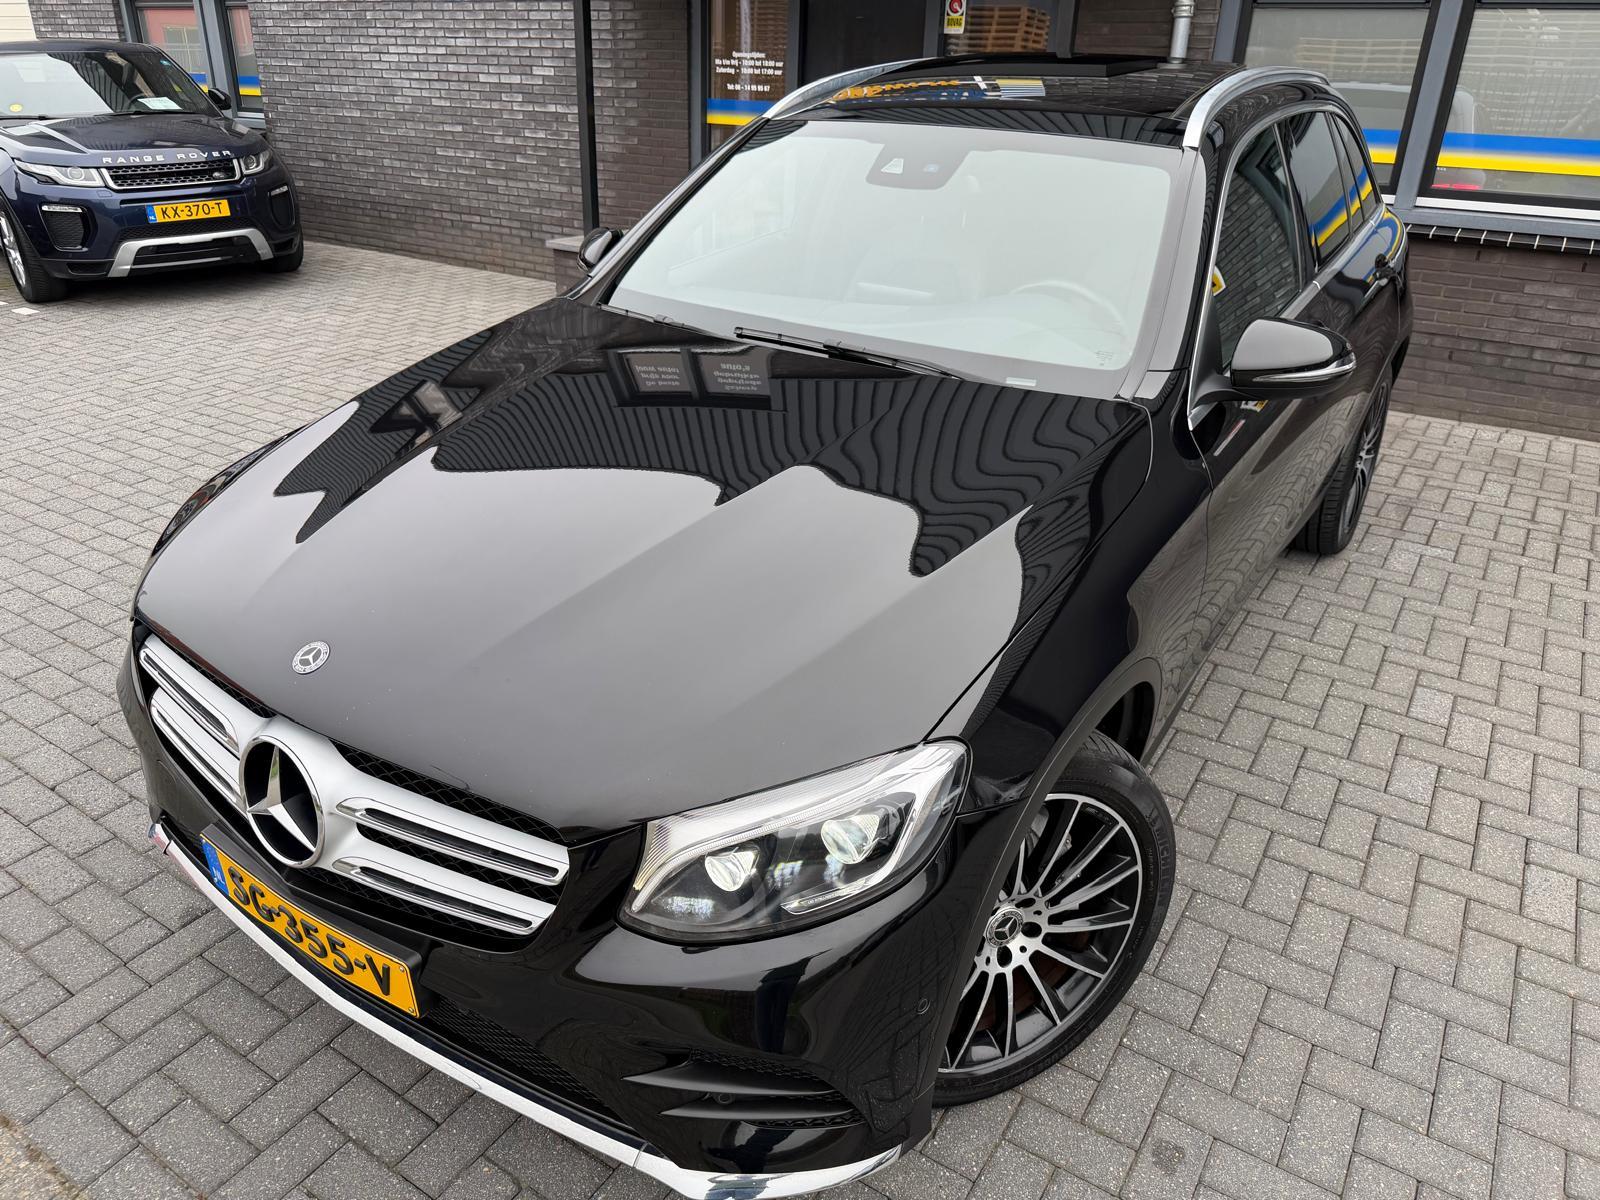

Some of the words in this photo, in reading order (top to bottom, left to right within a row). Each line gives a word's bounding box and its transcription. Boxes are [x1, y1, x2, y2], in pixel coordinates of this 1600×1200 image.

[103, 155, 165, 164] RANGE
[176, 150, 232, 159] ROVER
[161, 202, 222, 219] KX-370-T
[212, 866, 226, 885] NL
[228, 866, 390, 996] SG-355-V
